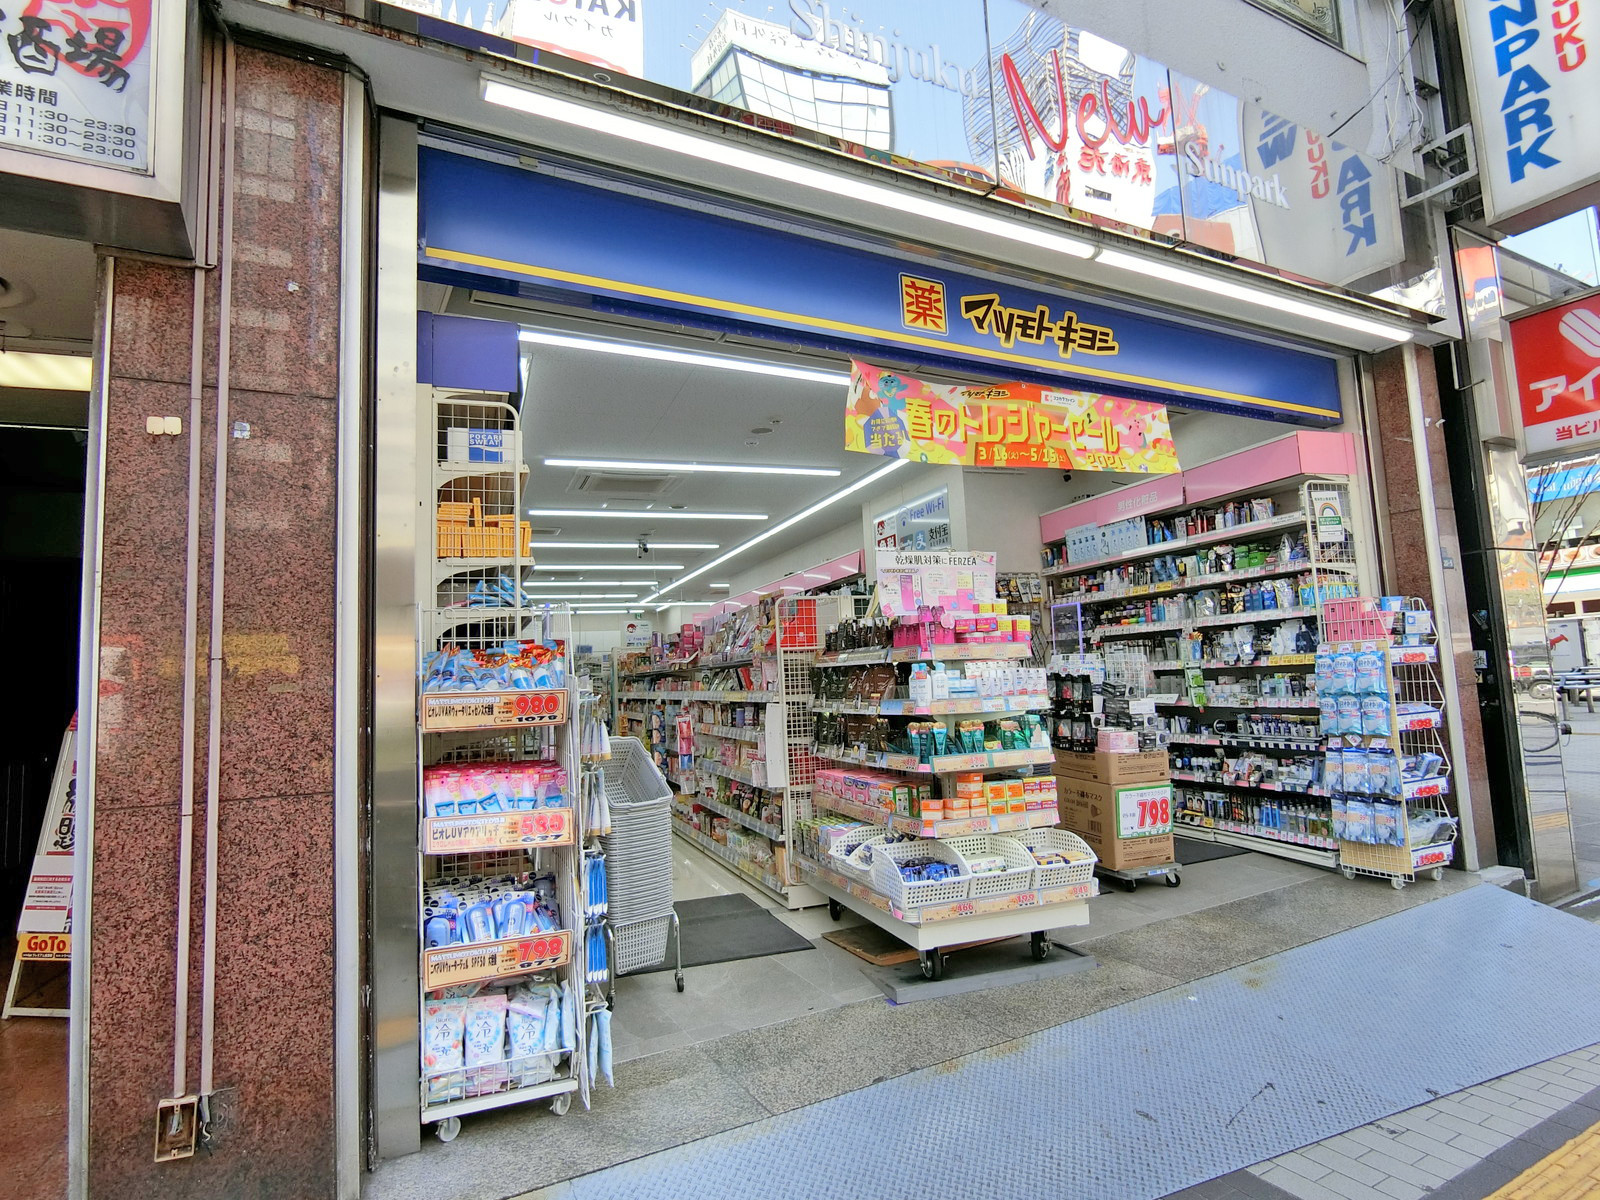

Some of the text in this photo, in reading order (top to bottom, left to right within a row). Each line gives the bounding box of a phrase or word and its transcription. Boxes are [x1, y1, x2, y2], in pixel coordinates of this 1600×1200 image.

[789, 0, 981, 99] Shinjuku
[1001, 48, 1165, 161] New
[904, 280, 943, 330] 薬
[962, 295, 1117, 356] マツモトキヨシ
[469, 433, 502, 441] POCARI
[909, 496, 945, 521] Free Wi-Fi
[949, 556, 977, 566] FERZEA
[515, 693, 560, 716] 980
[1137, 798, 1170, 829] 798
[519, 936, 563, 962] 798
[434, 1023, 452, 1041] 冷
[475, 1020, 492, 1038] 冷
[521, 1023, 537, 1041] 冷
